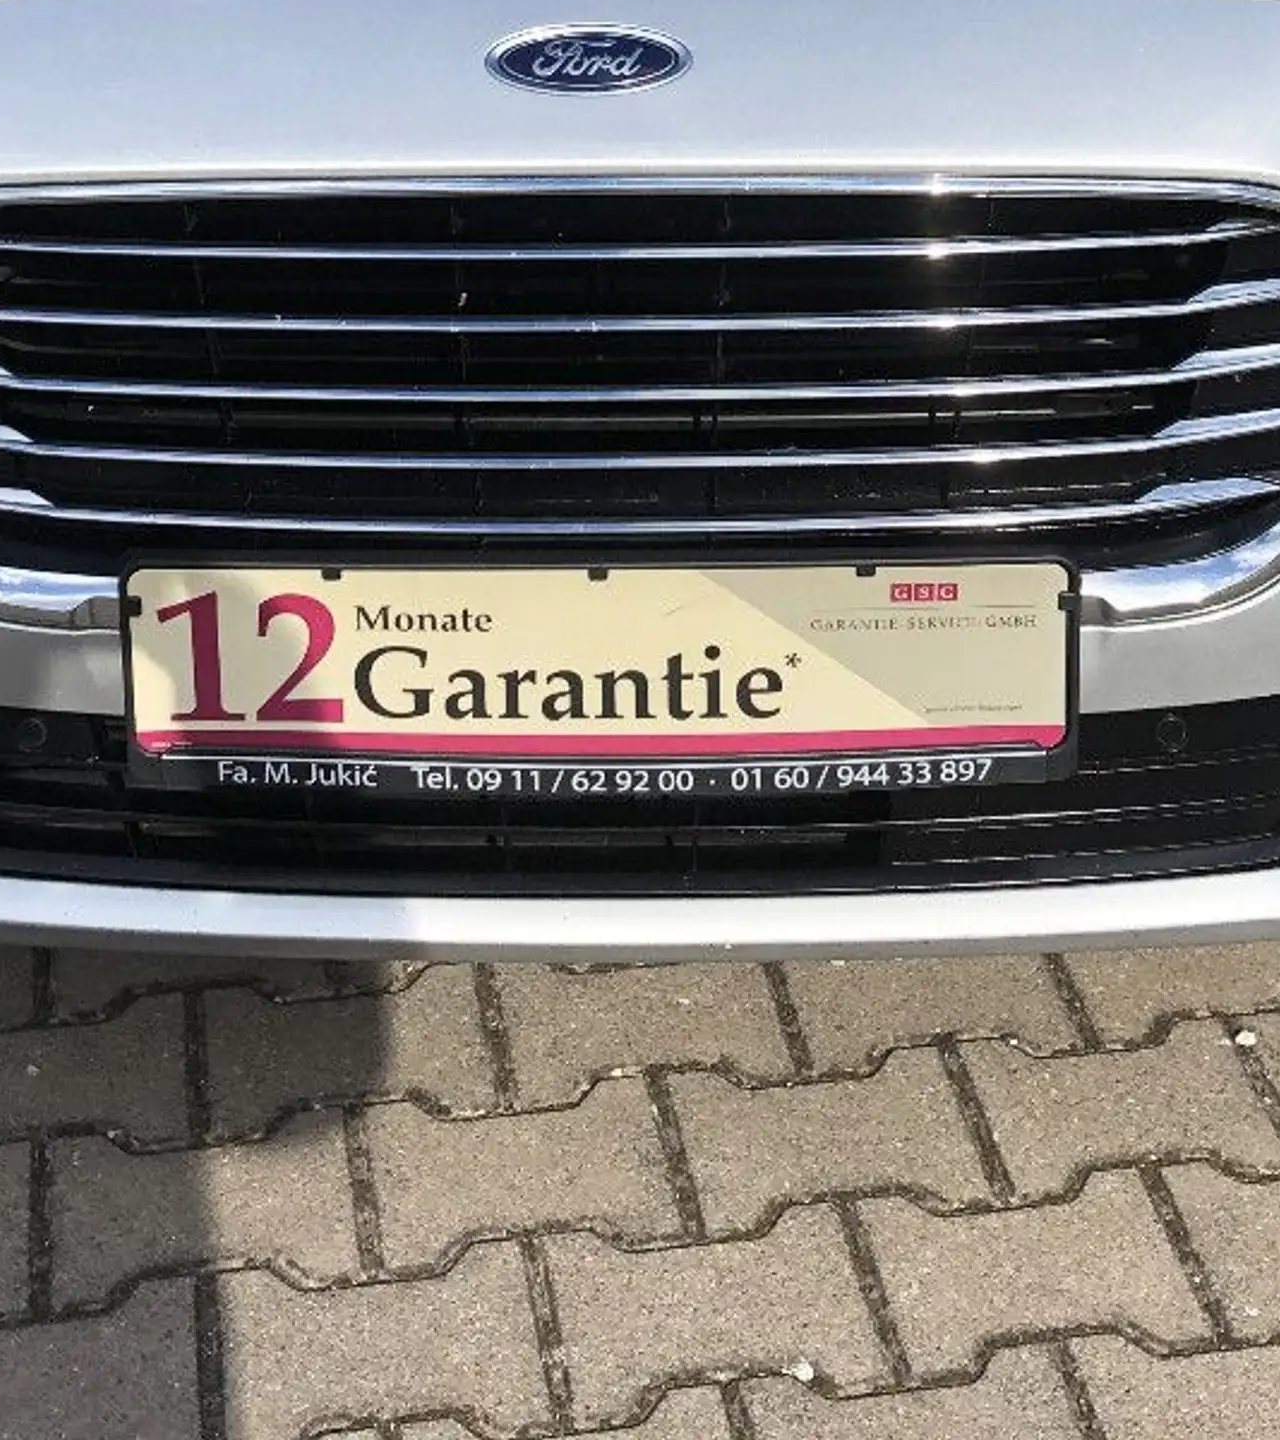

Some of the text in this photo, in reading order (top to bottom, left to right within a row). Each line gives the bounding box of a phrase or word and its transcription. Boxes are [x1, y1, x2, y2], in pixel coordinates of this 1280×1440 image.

[532, 39, 644, 76] Ford
[354, 605, 493, 633] Monate
[157, 591, 344, 723] 12
[218, 762, 379, 787] Fa. M. Jukić
[411, 766, 459, 790] Tel.
[466, 768, 503, 791] 09
[511, 770, 542, 792] 11
[571, 770, 608, 792] 62
[616, 770, 651, 792] 92
[658, 770, 695, 792] 00
[731, 767, 763, 791] 01
[773, 767, 810, 789] 60
[836, 764, 890, 787] 944
[897, 762, 931, 785] 33
[939, 758, 992, 782] 897
